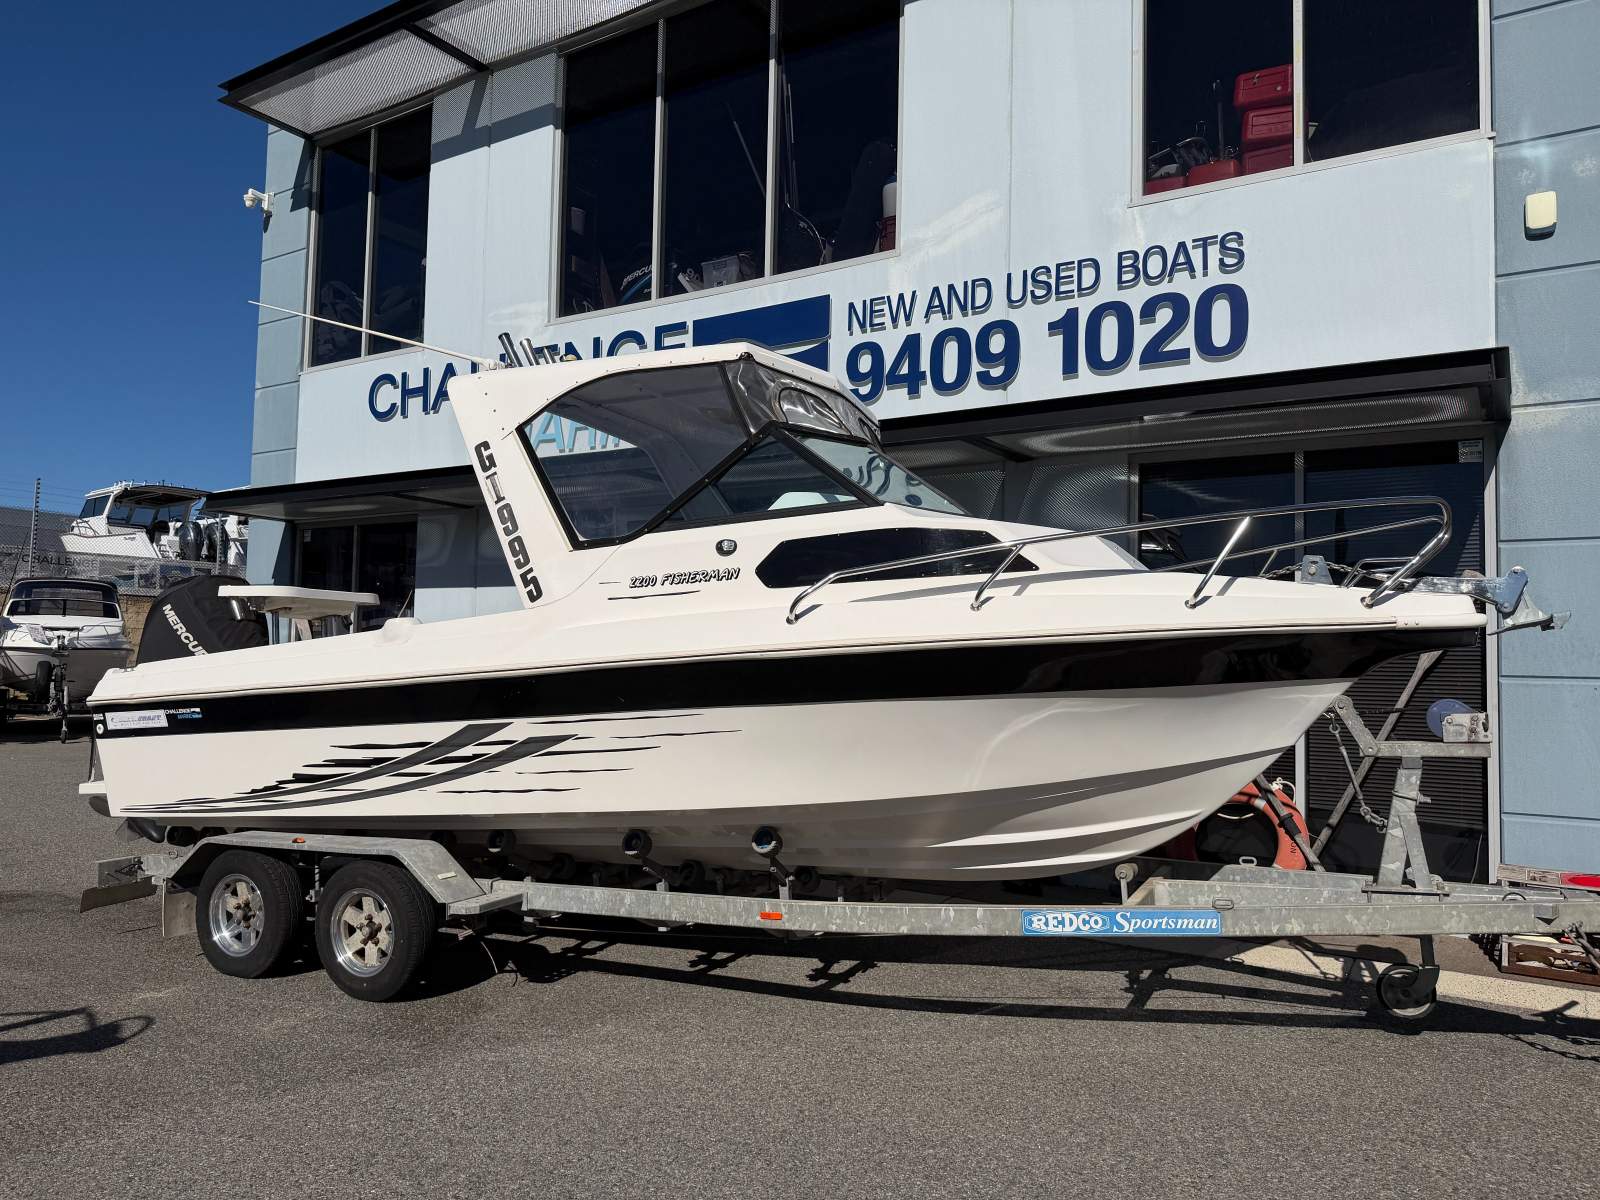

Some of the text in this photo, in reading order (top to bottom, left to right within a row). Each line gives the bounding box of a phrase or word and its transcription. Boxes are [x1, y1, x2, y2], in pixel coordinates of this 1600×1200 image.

[621, 265, 652, 290] MERCU
[847, 231, 1245, 335] NEW AND USED BOATS
[846, 283, 1249, 403] 9409 1020
[629, 567, 740, 588] 2200 FISHERMAN
[1031, 911, 1218, 933] REDCO Sportsman
